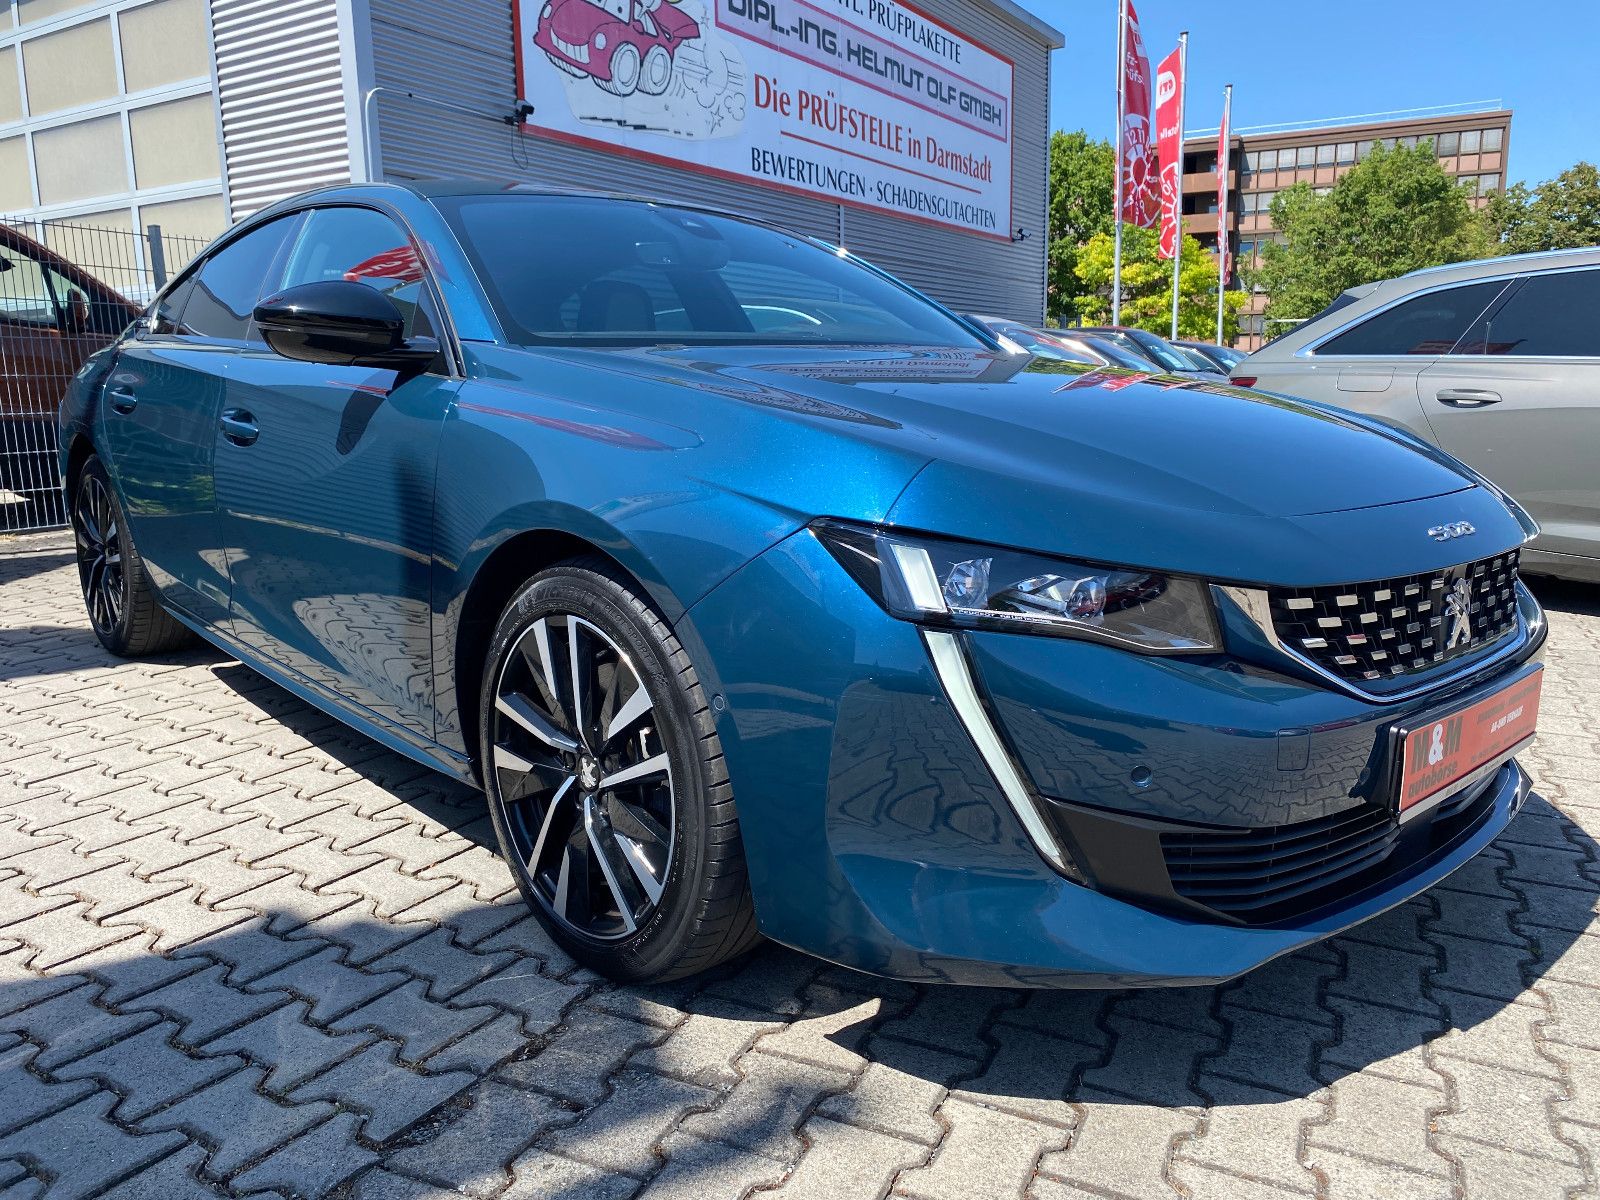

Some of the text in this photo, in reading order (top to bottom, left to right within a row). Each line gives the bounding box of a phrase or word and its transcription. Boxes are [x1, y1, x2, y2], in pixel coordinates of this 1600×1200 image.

[868, 0, 961, 64] PRÜFPLAKETTE
[847, 38, 924, 92] HELMUT
[927, 76, 957, 105] OLF
[959, 91, 1002, 127] GMBH
[754, 73, 993, 183] Die PRÜFSTELLE in Darmstadt
[751, 146, 997, 229] BEWERTUNGEN SCHADENSGUTACHTEN
[1427, 521, 1476, 541] 508
[1410, 715, 1464, 776] M&M
